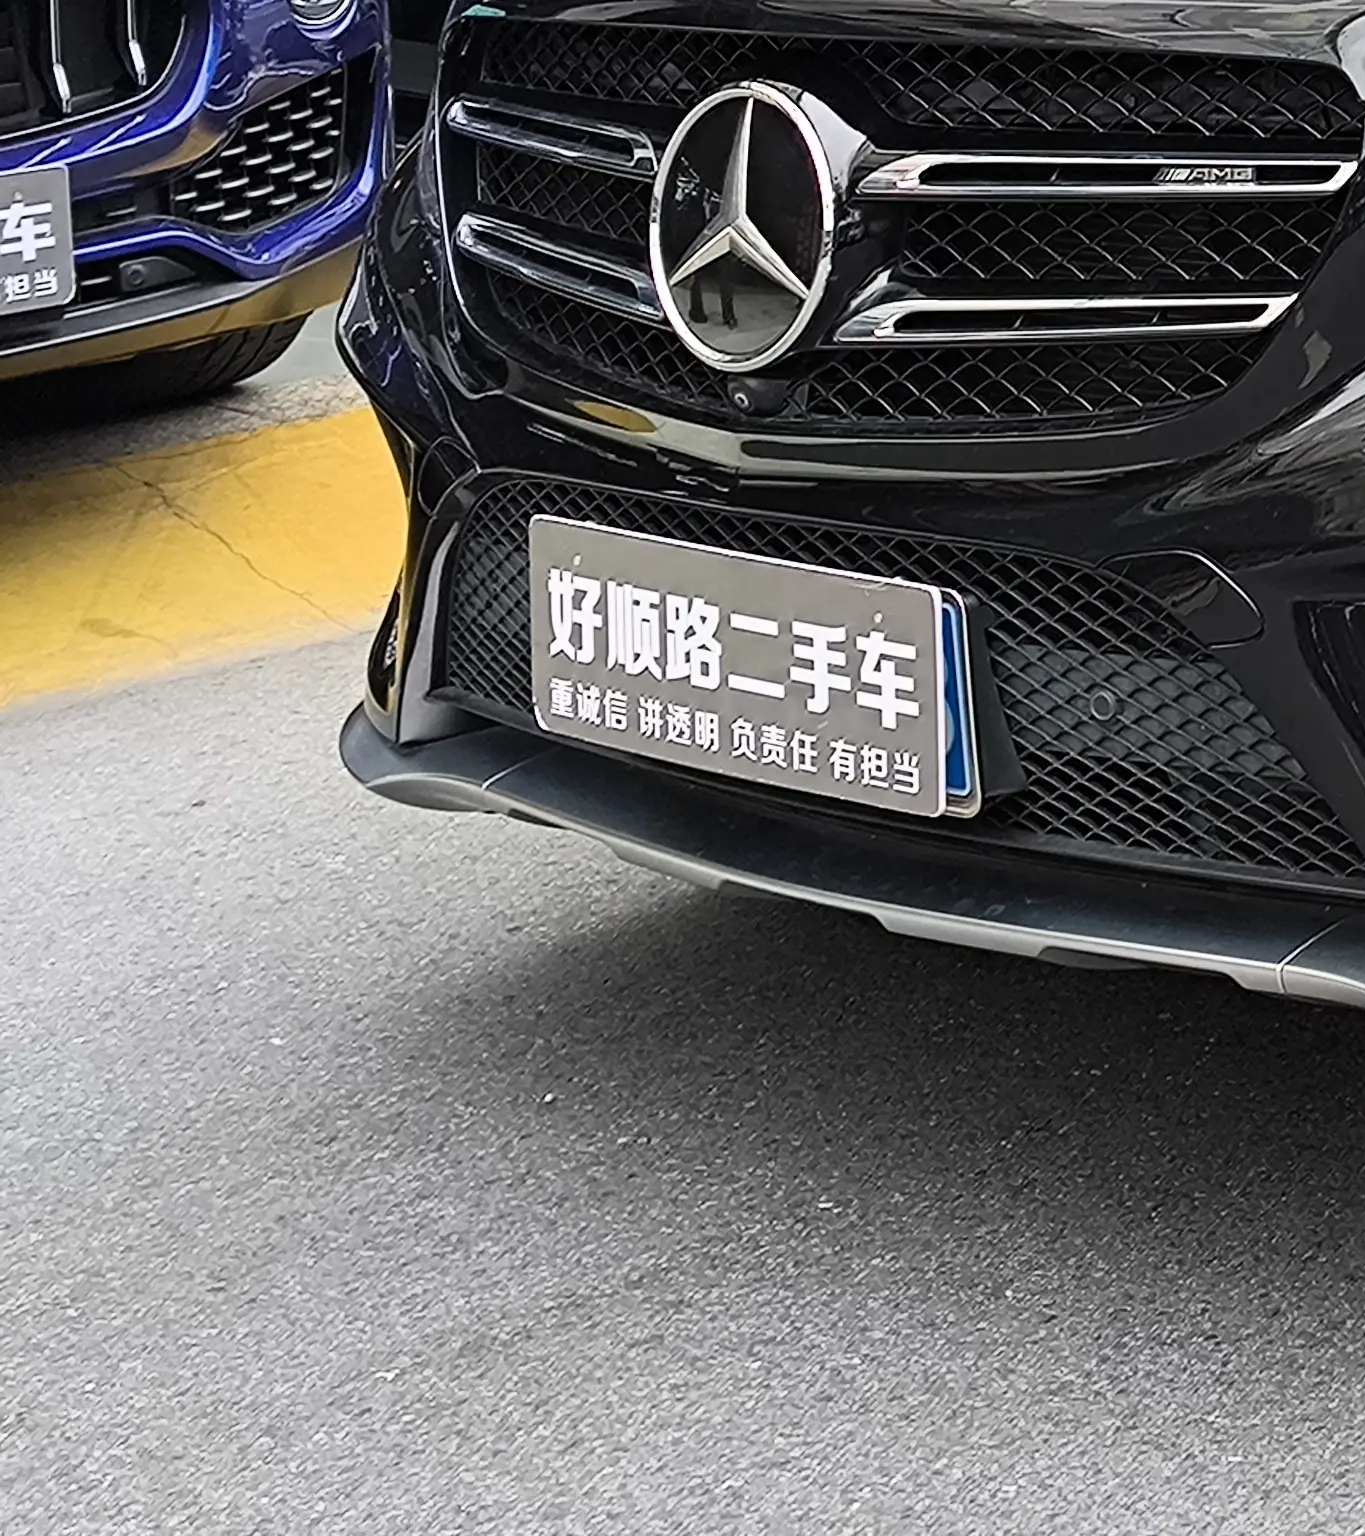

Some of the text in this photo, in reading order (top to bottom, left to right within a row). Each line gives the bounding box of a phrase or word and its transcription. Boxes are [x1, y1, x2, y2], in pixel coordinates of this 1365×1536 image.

[1175, 167, 1255, 182] AMG
[547, 568, 921, 731] 好顺路二手车
[549, 677, 922, 795] 重诚信 讲透明 负责任 有担当
